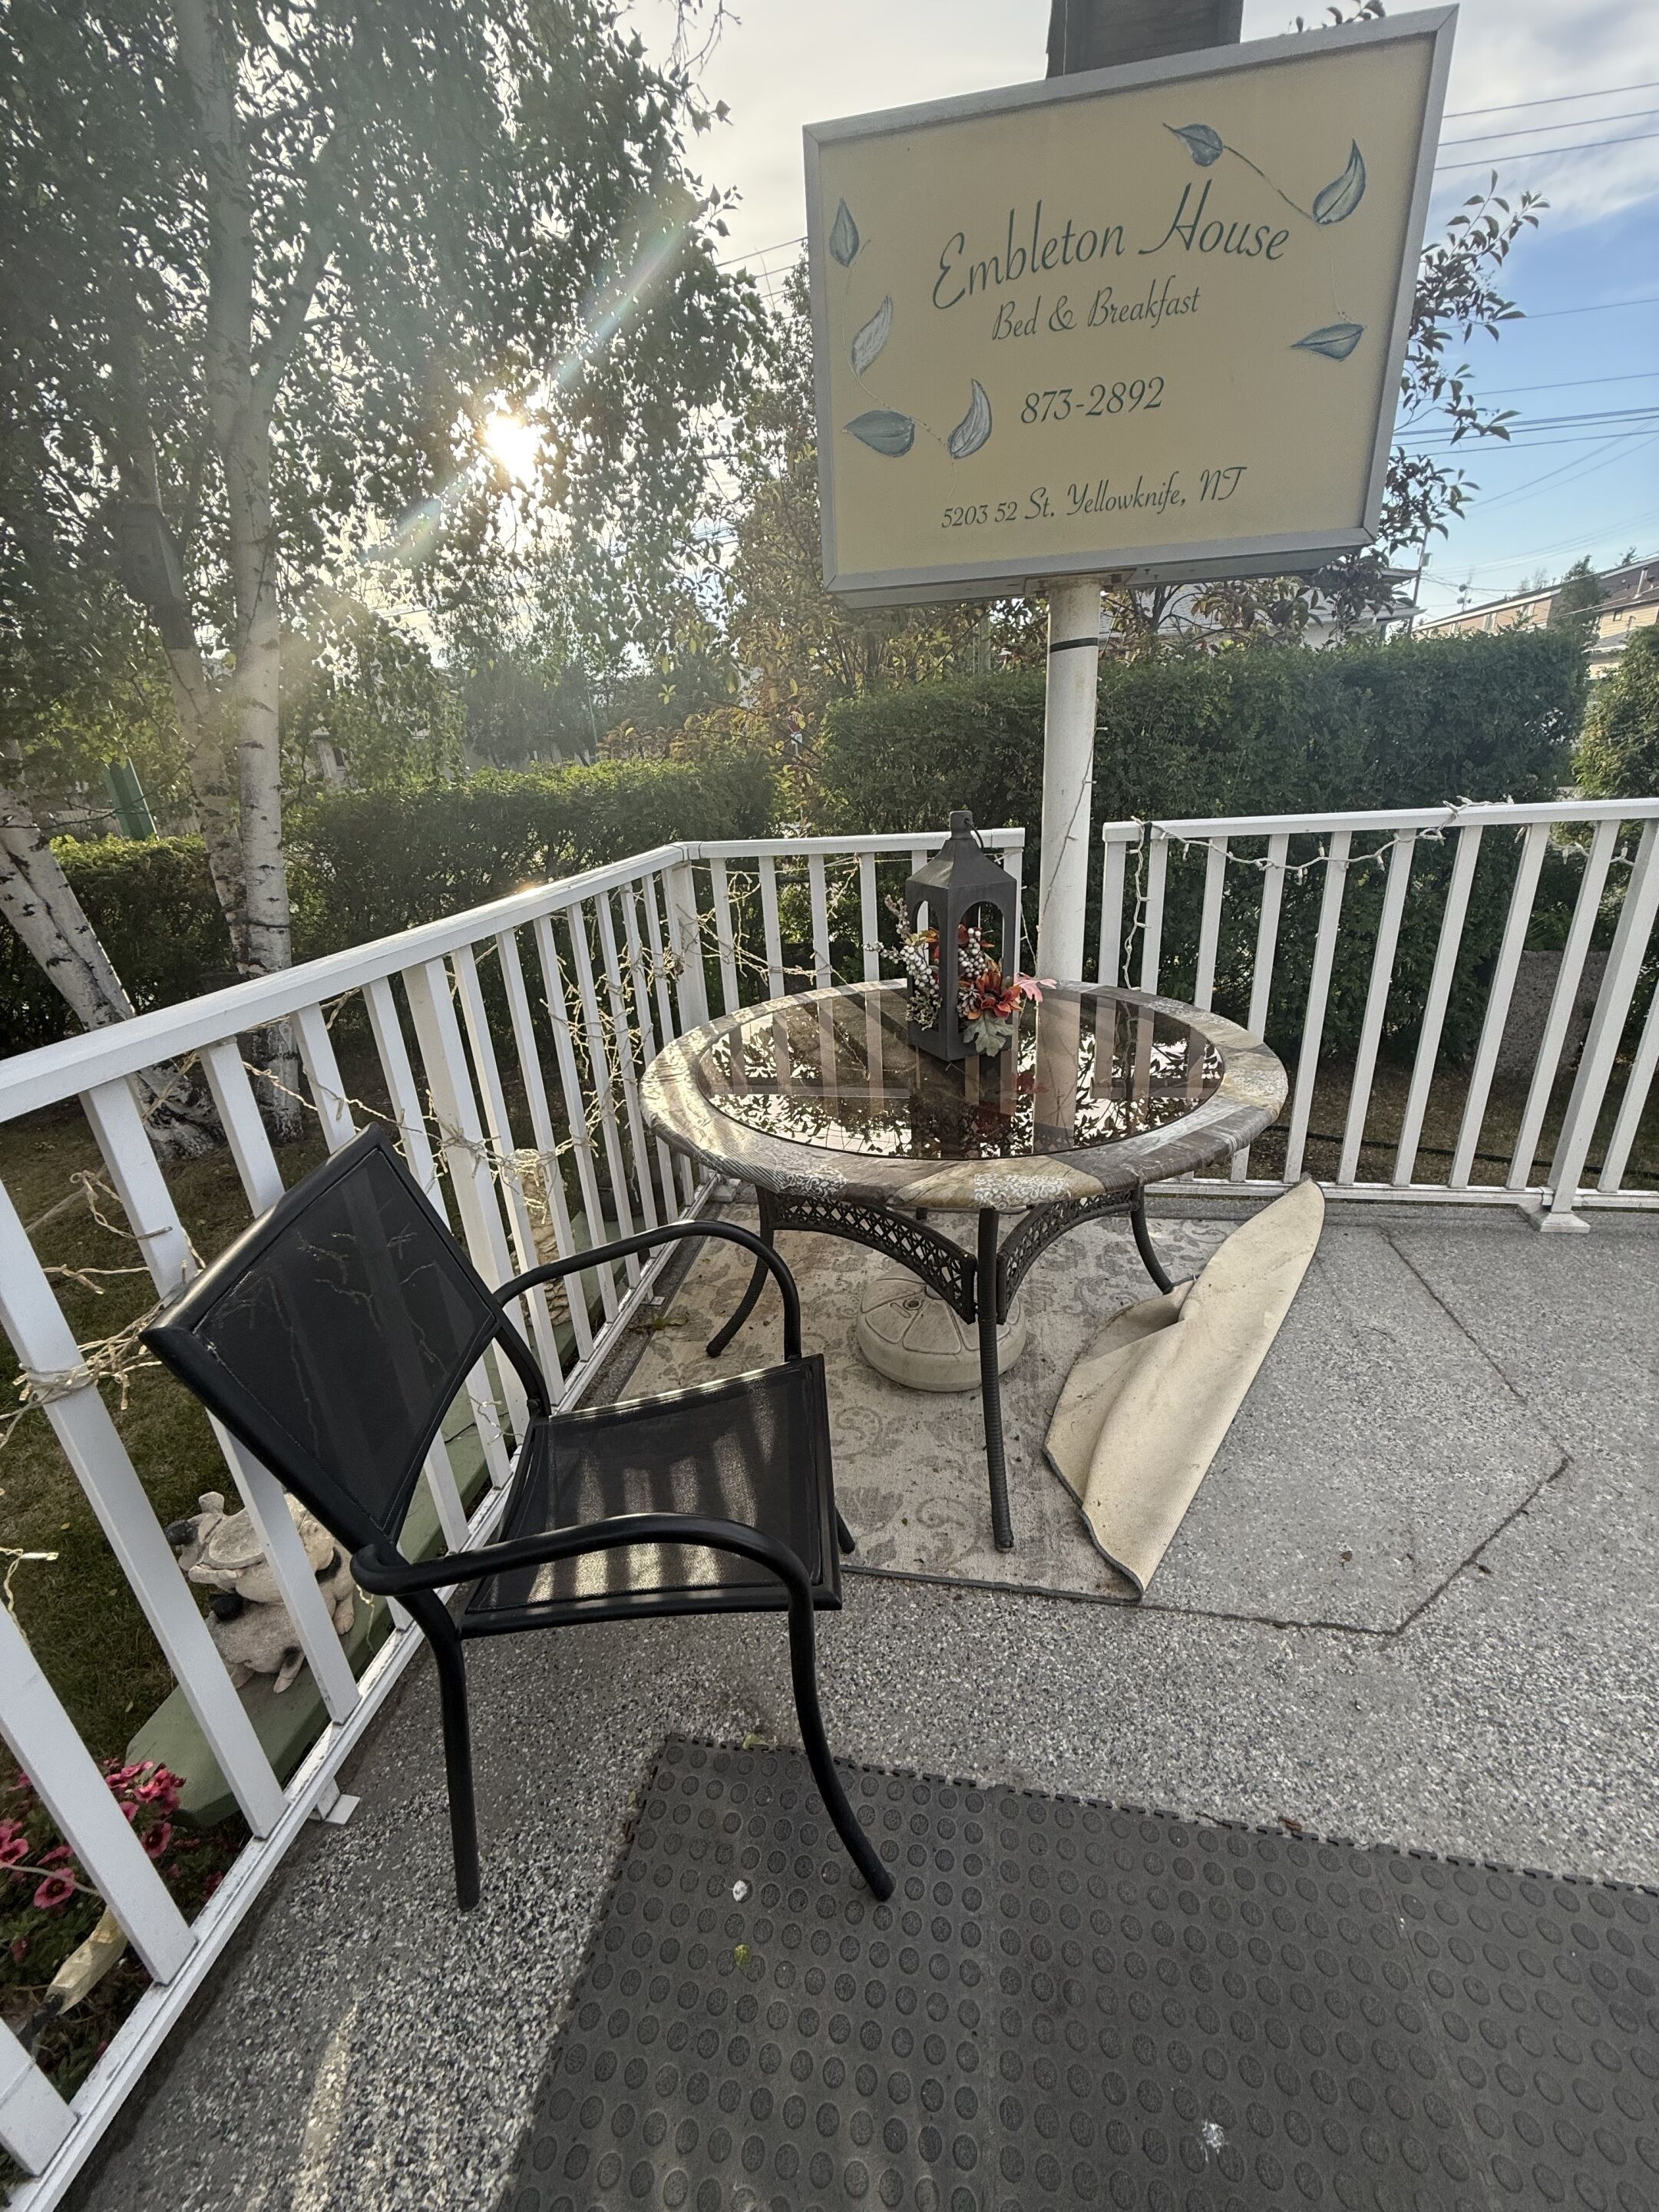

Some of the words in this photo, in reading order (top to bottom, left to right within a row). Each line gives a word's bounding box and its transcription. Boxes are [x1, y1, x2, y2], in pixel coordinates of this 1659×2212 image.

[932, 199, 1125, 309] Embleton
[1138, 178, 1291, 260] House
[992, 295, 1041, 340] Bed
[1049, 295, 1076, 332] &
[1087, 274, 1201, 329] Breakfast
[1020, 376, 1165, 424] 873-2892
[941, 504, 989, 528] 5203
[994, 501, 1018, 523] 52
[1024, 486, 1056, 520] St.
[1067, 470, 1186, 515] Yellowknife,
[1200, 466, 1248, 502] NT
